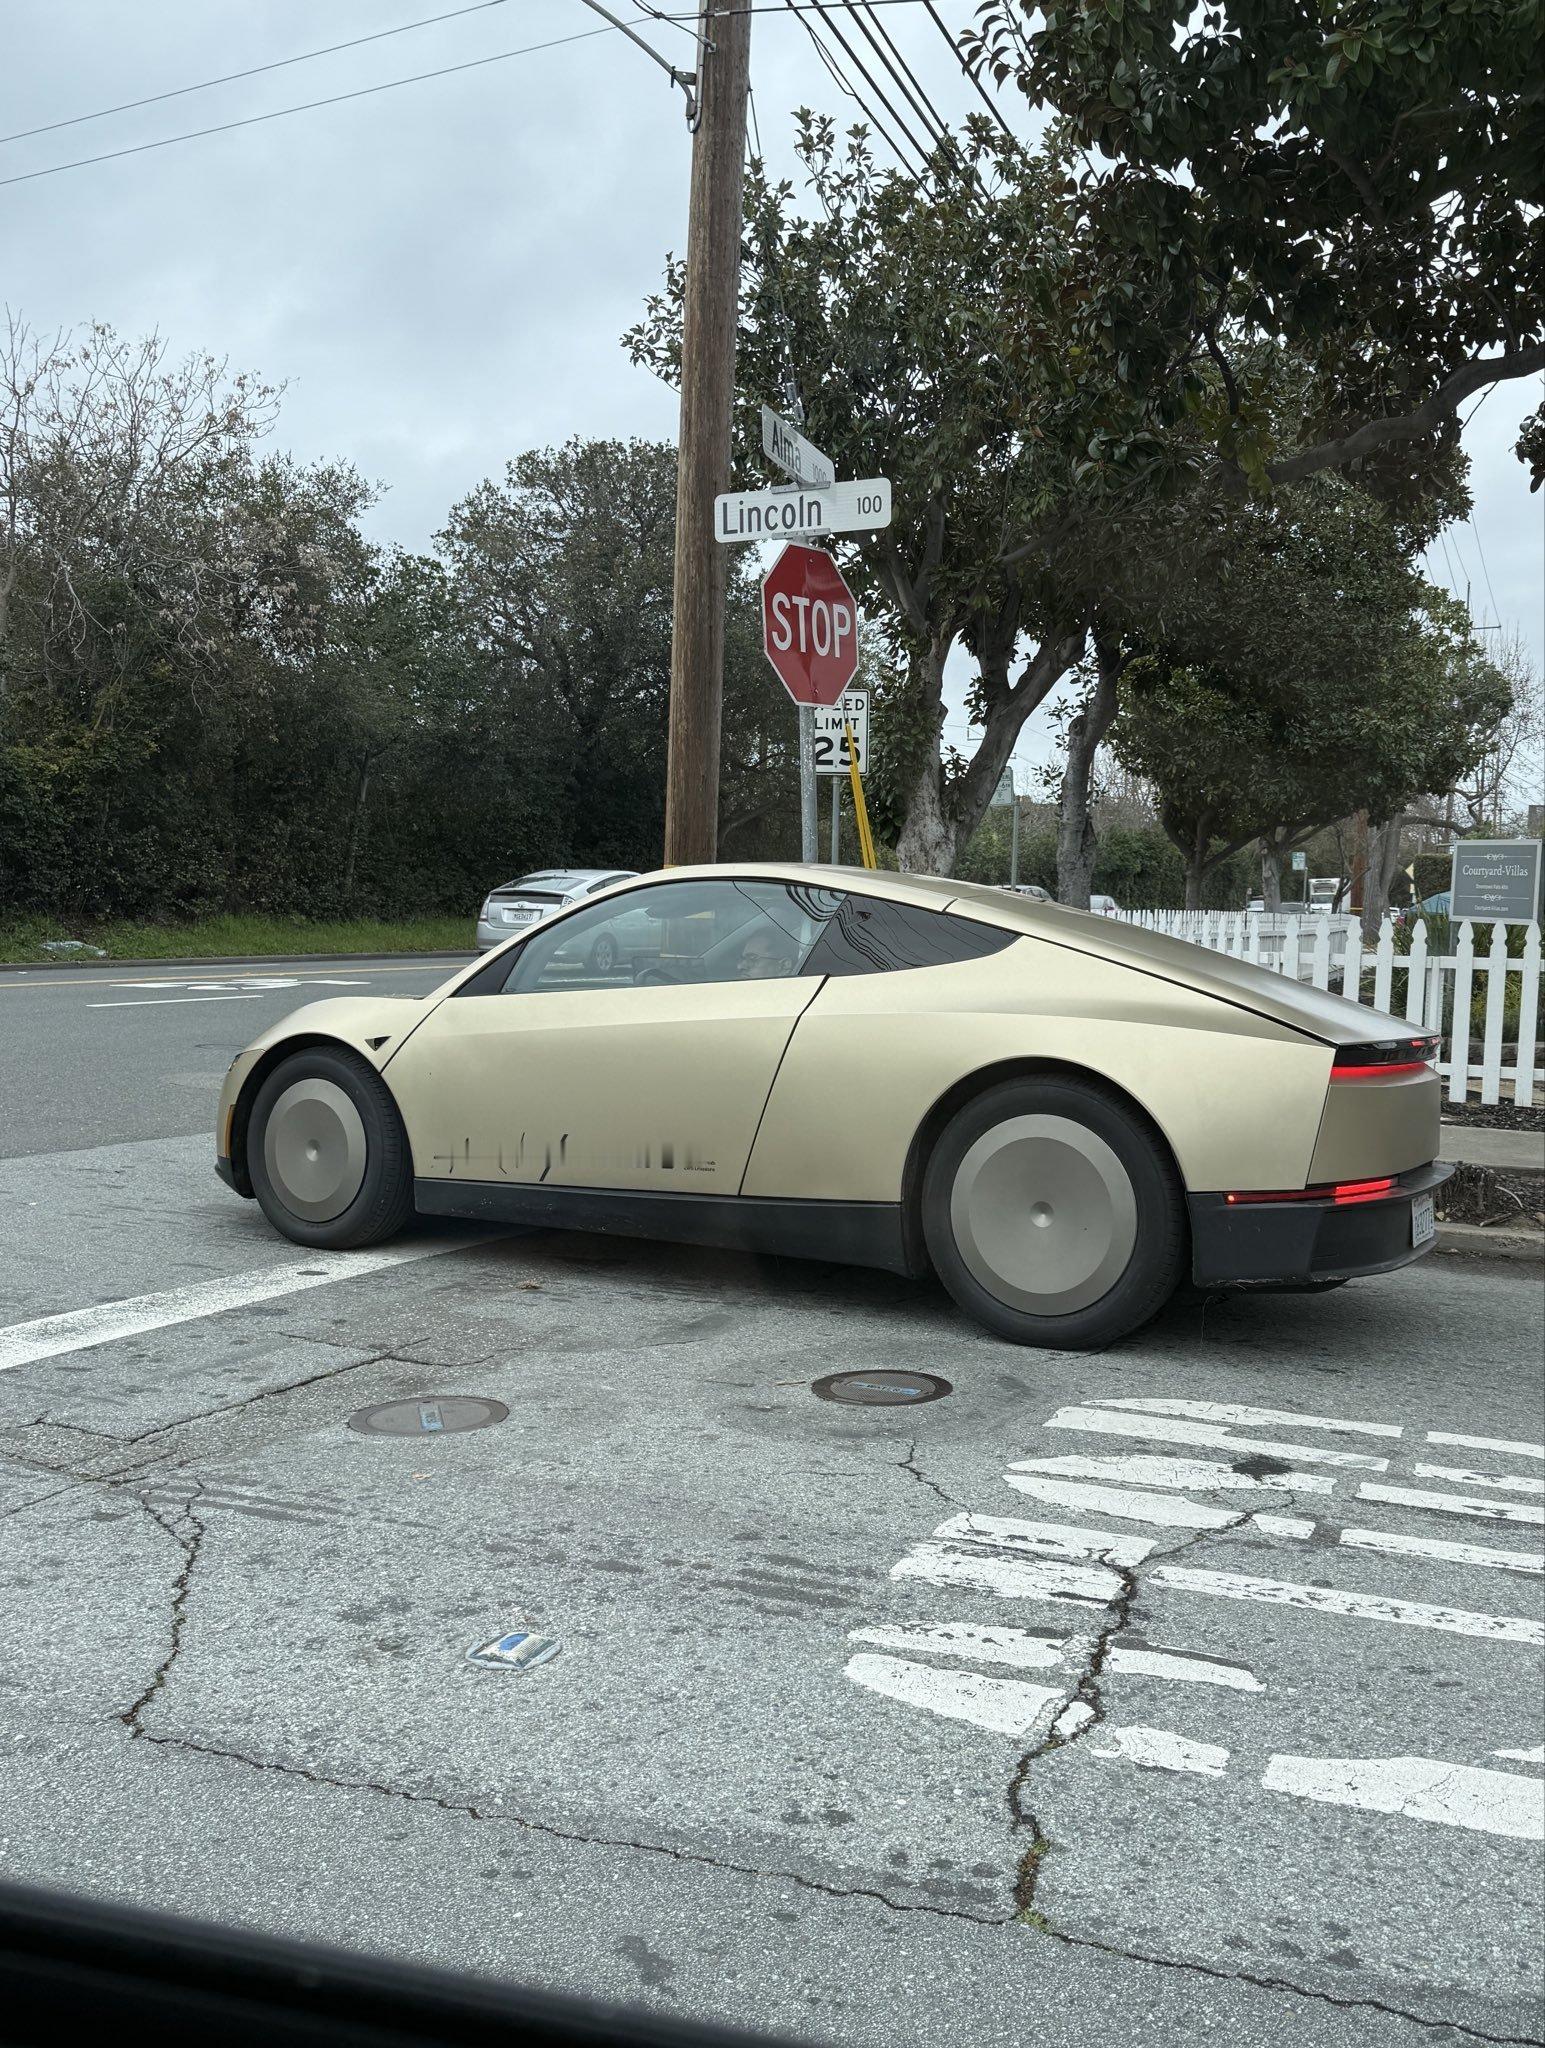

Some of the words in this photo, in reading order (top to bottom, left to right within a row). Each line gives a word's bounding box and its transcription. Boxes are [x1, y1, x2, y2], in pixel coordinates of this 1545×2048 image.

[771, 420, 802, 473] Alma
[722, 494, 822, 535] Lincoln
[856, 495, 883, 515] 100
[771, 591, 851, 659] STOP
[815, 717, 860, 730] LIMT
[815, 736, 861, 767] 25
[1462, 864, 1529, 878] Courtyard-Villas
